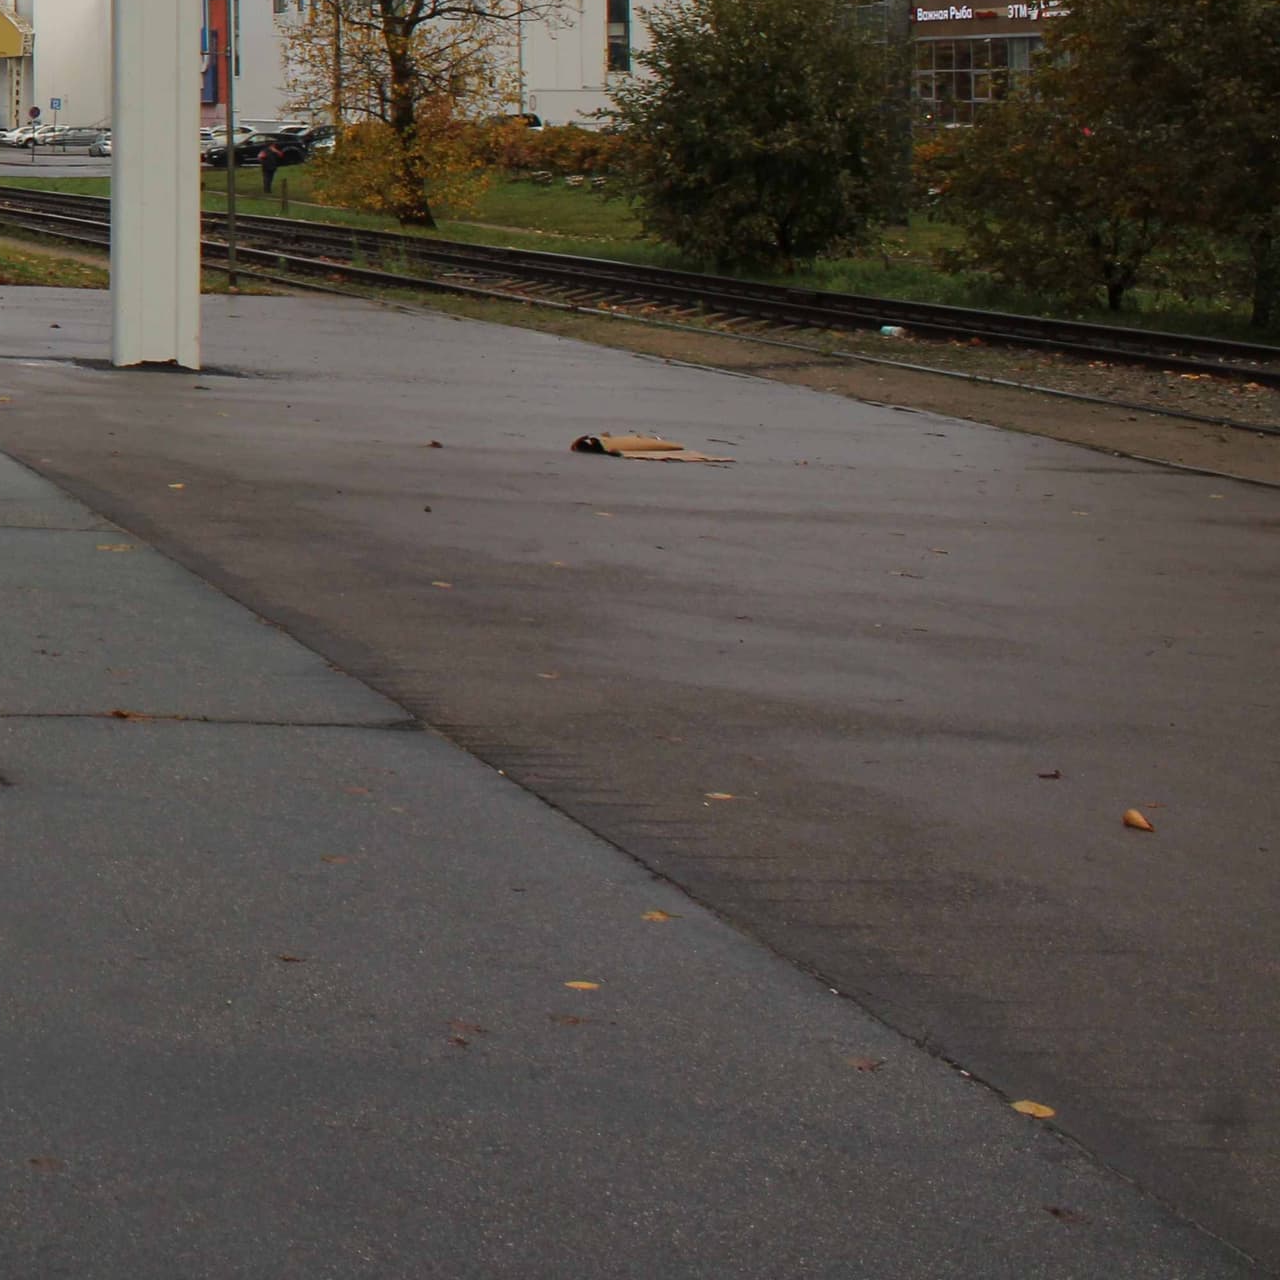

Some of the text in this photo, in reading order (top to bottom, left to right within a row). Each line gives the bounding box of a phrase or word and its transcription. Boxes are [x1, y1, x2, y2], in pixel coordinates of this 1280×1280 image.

[917, 7, 948, 21] Важная
[950, 4, 973, 19] Рыба
[1008, 4, 1028, 19] ЭТМ
